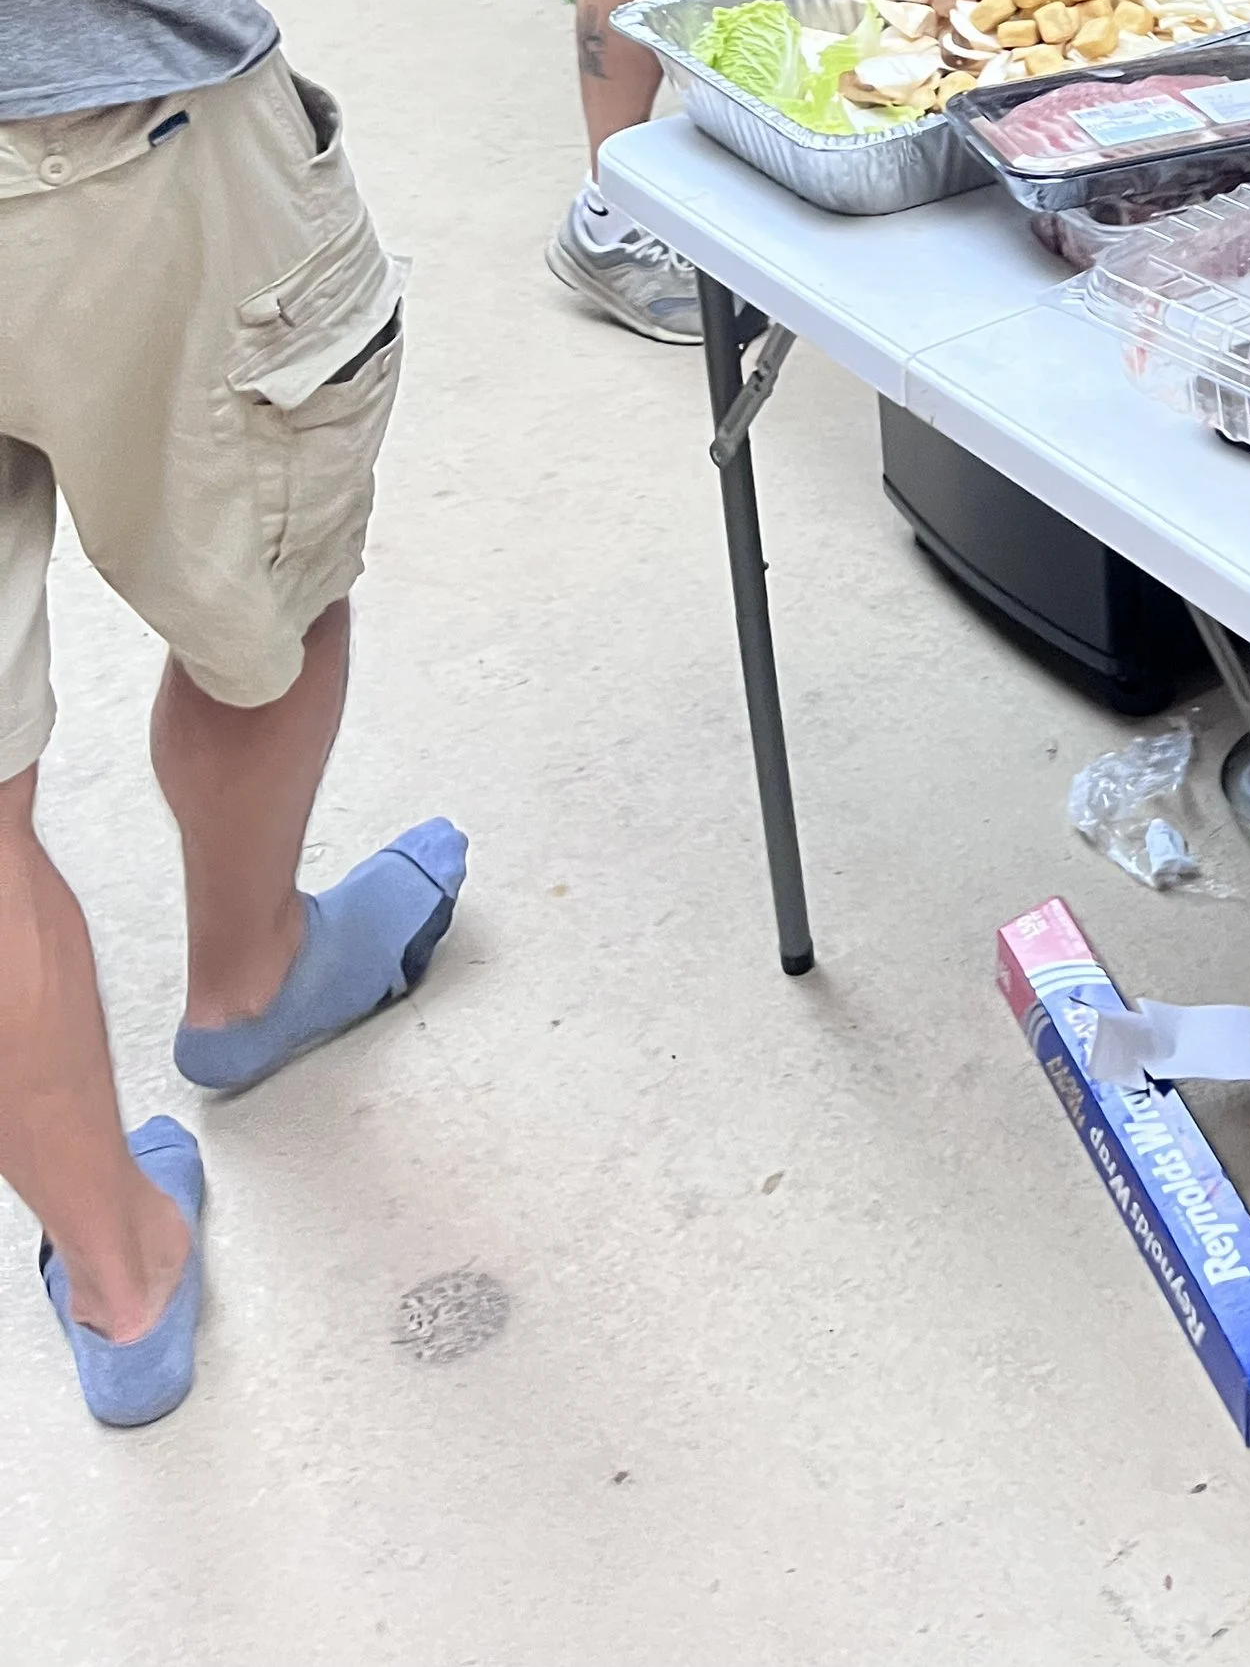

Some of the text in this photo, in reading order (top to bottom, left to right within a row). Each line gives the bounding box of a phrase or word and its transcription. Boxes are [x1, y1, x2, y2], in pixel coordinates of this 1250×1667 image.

[1121, 1086, 1175, 1156] Wra
[1089, 1126, 1132, 1213] Wrap
[1129, 1201, 1207, 1347] Reynolds
